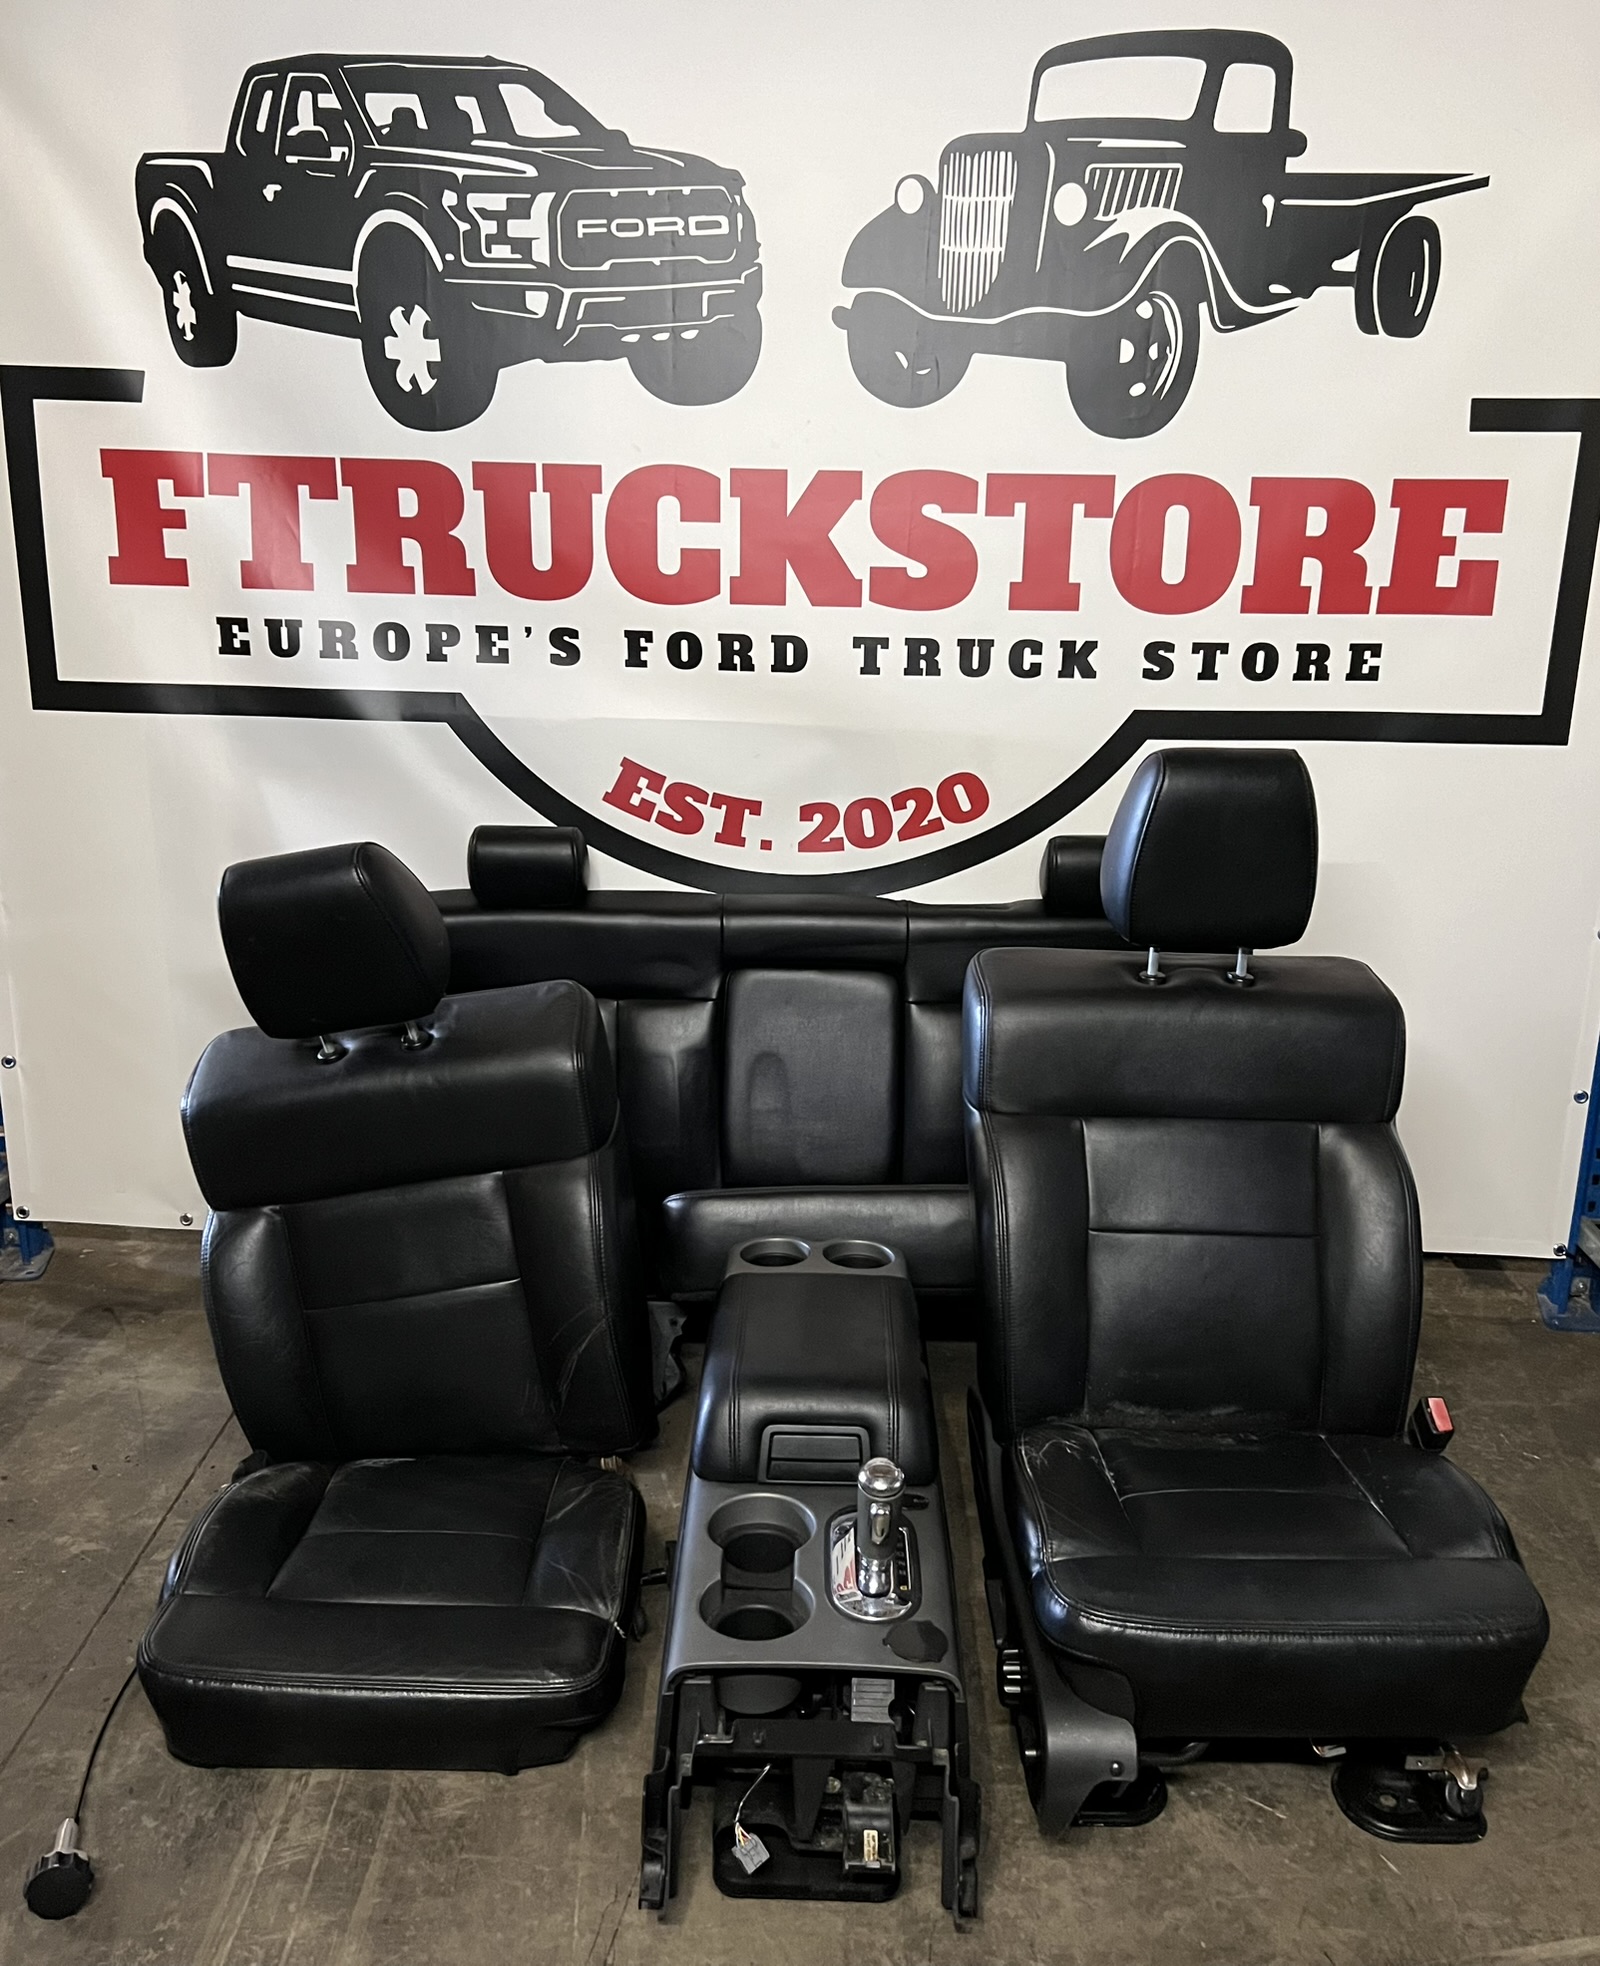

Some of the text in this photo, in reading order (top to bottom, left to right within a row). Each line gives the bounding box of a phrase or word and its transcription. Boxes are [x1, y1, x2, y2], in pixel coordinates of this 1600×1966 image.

[577, 214, 730, 239] FORD
[100, 448, 1509, 617] FTRUCKSTORE
[216, 616, 1383, 682] EUROPE'S FORD TRUCK STORE
[602, 757, 991, 854] EST. 2020
